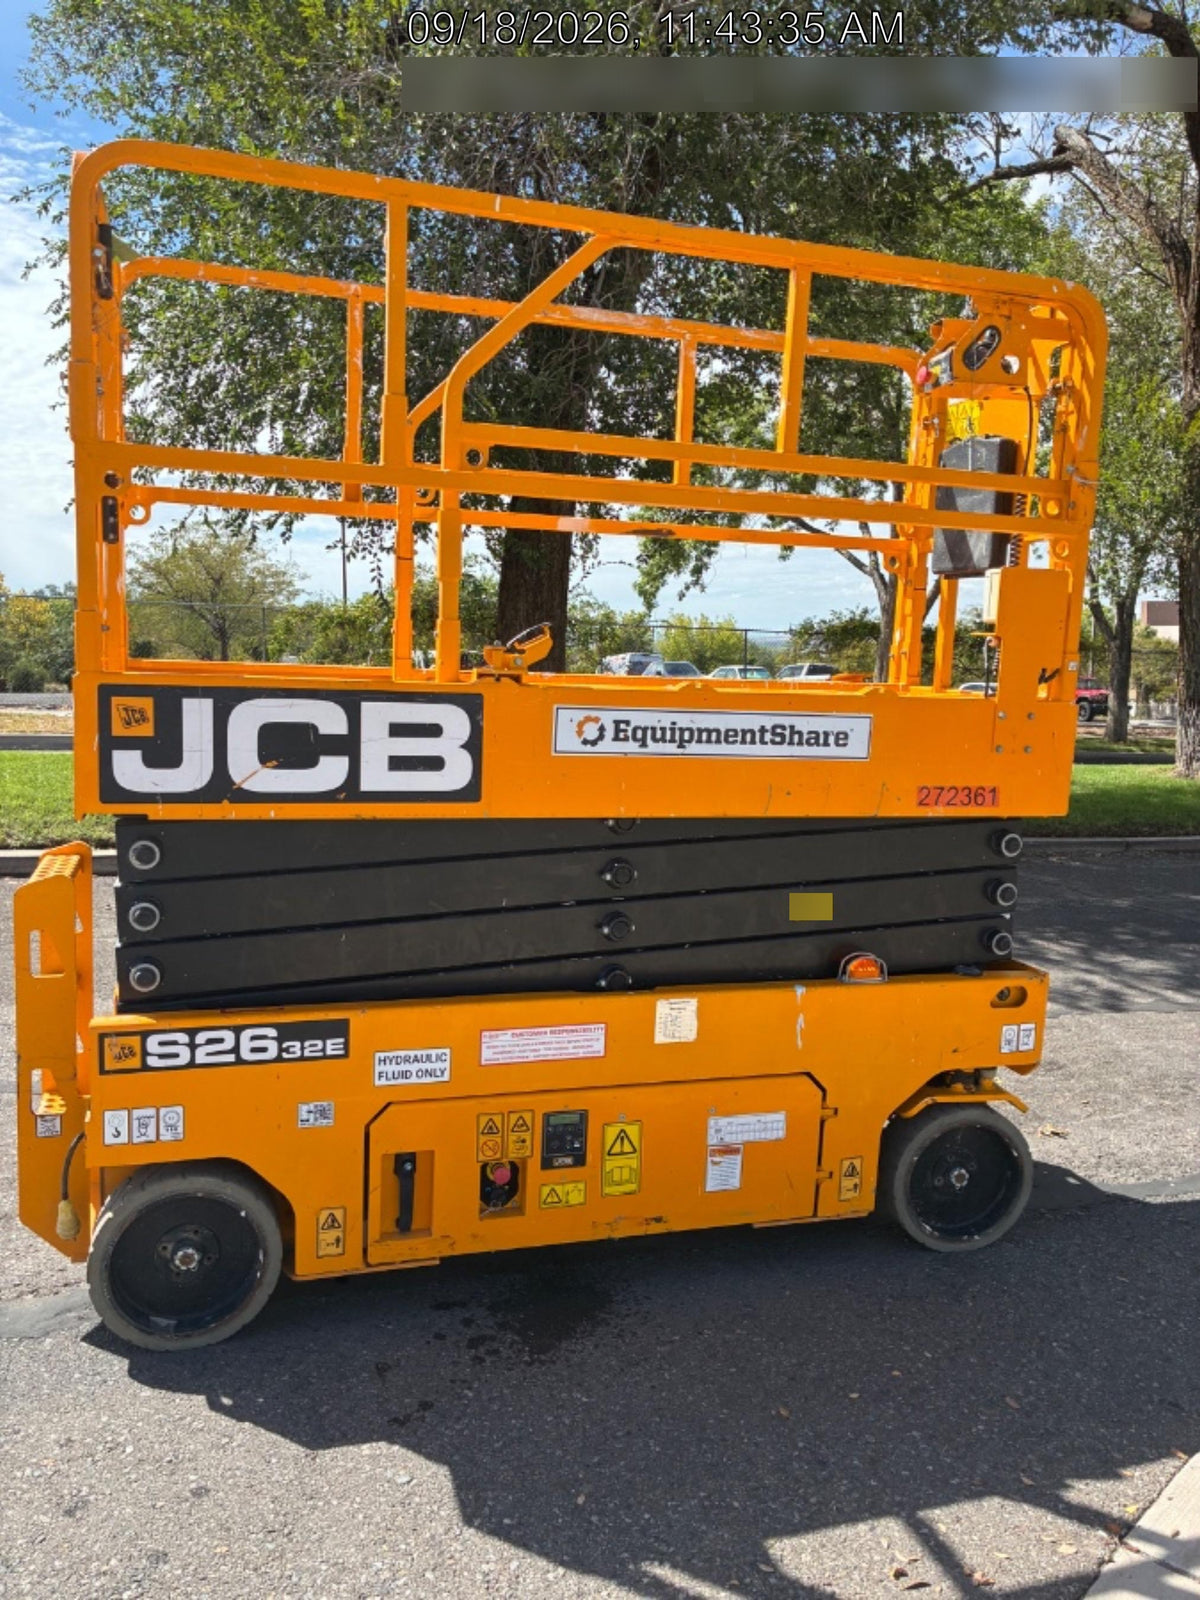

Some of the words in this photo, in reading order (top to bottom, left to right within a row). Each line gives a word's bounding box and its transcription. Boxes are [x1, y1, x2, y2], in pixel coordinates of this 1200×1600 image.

[111, 698, 474, 793] JCB
[611, 719, 850, 749] EquipmentShare
[918, 786, 997, 806] 272361
[145, 1027, 279, 1068] S26
[281, 1037, 345, 1059] 32E
[378, 1052, 448, 1066] HYDRAULIC
[378, 1069, 413, 1081] FLUID
[415, 1067, 447, 1078] ONLY
